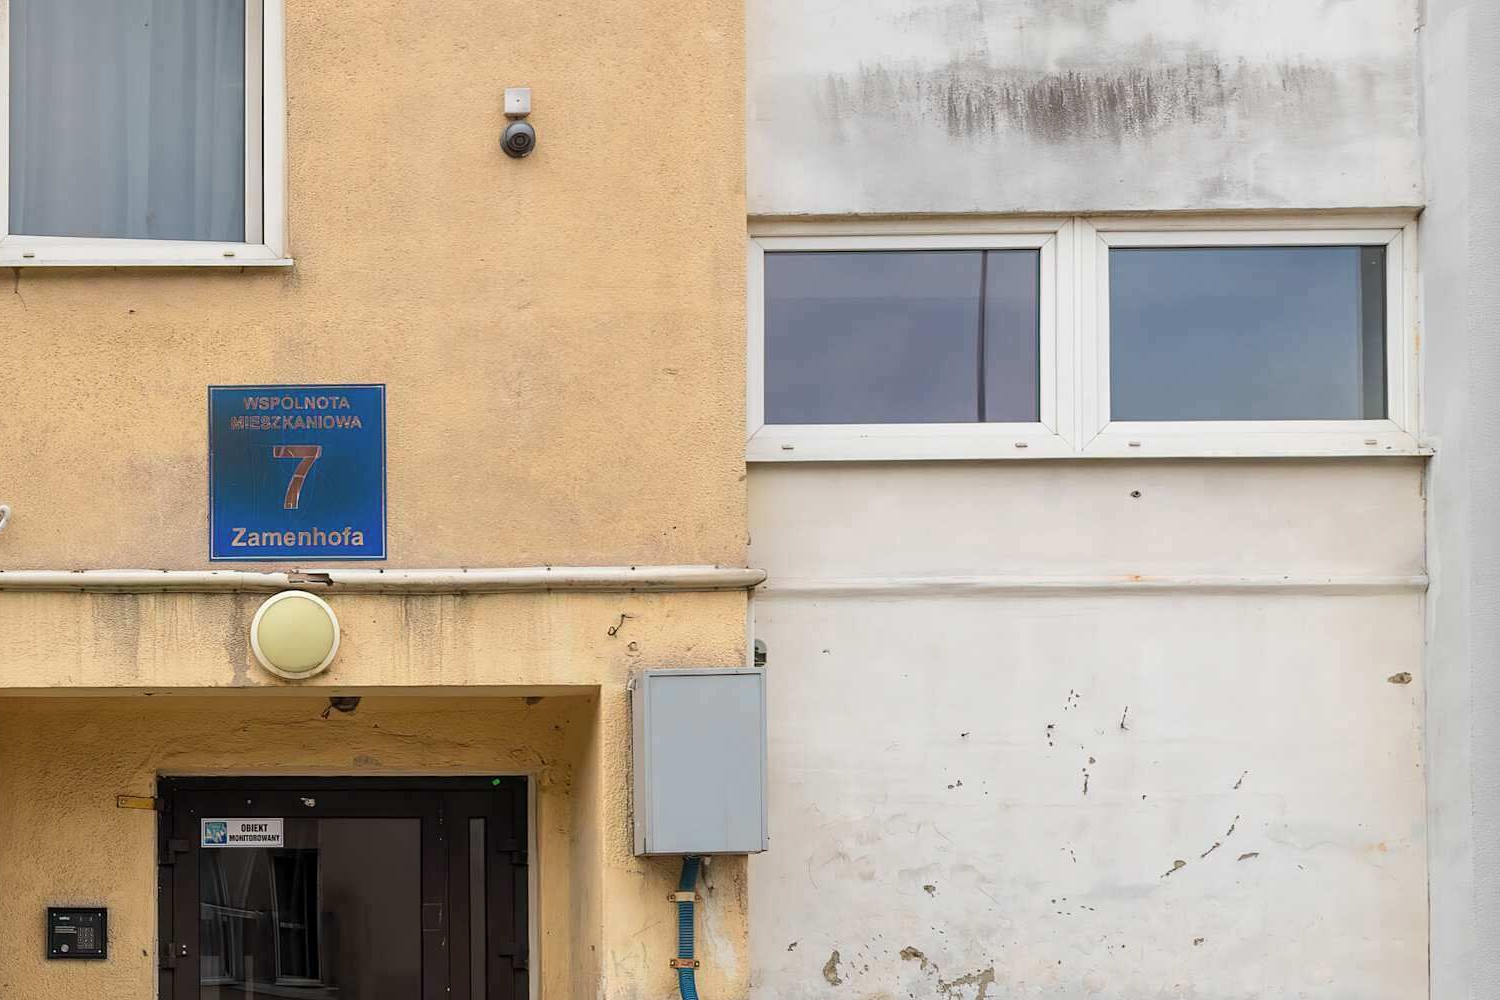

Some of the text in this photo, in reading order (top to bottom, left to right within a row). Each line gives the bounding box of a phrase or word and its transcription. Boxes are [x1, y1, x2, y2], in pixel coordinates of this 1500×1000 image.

[230, 415, 363, 431] MIESZKANIOWA
[273, 445, 322, 509] 7
[231, 527, 364, 547] Zamenhofa
[240, 823, 269, 833] OBIEKT
[229, 834, 281, 842] MONITOROWANY
